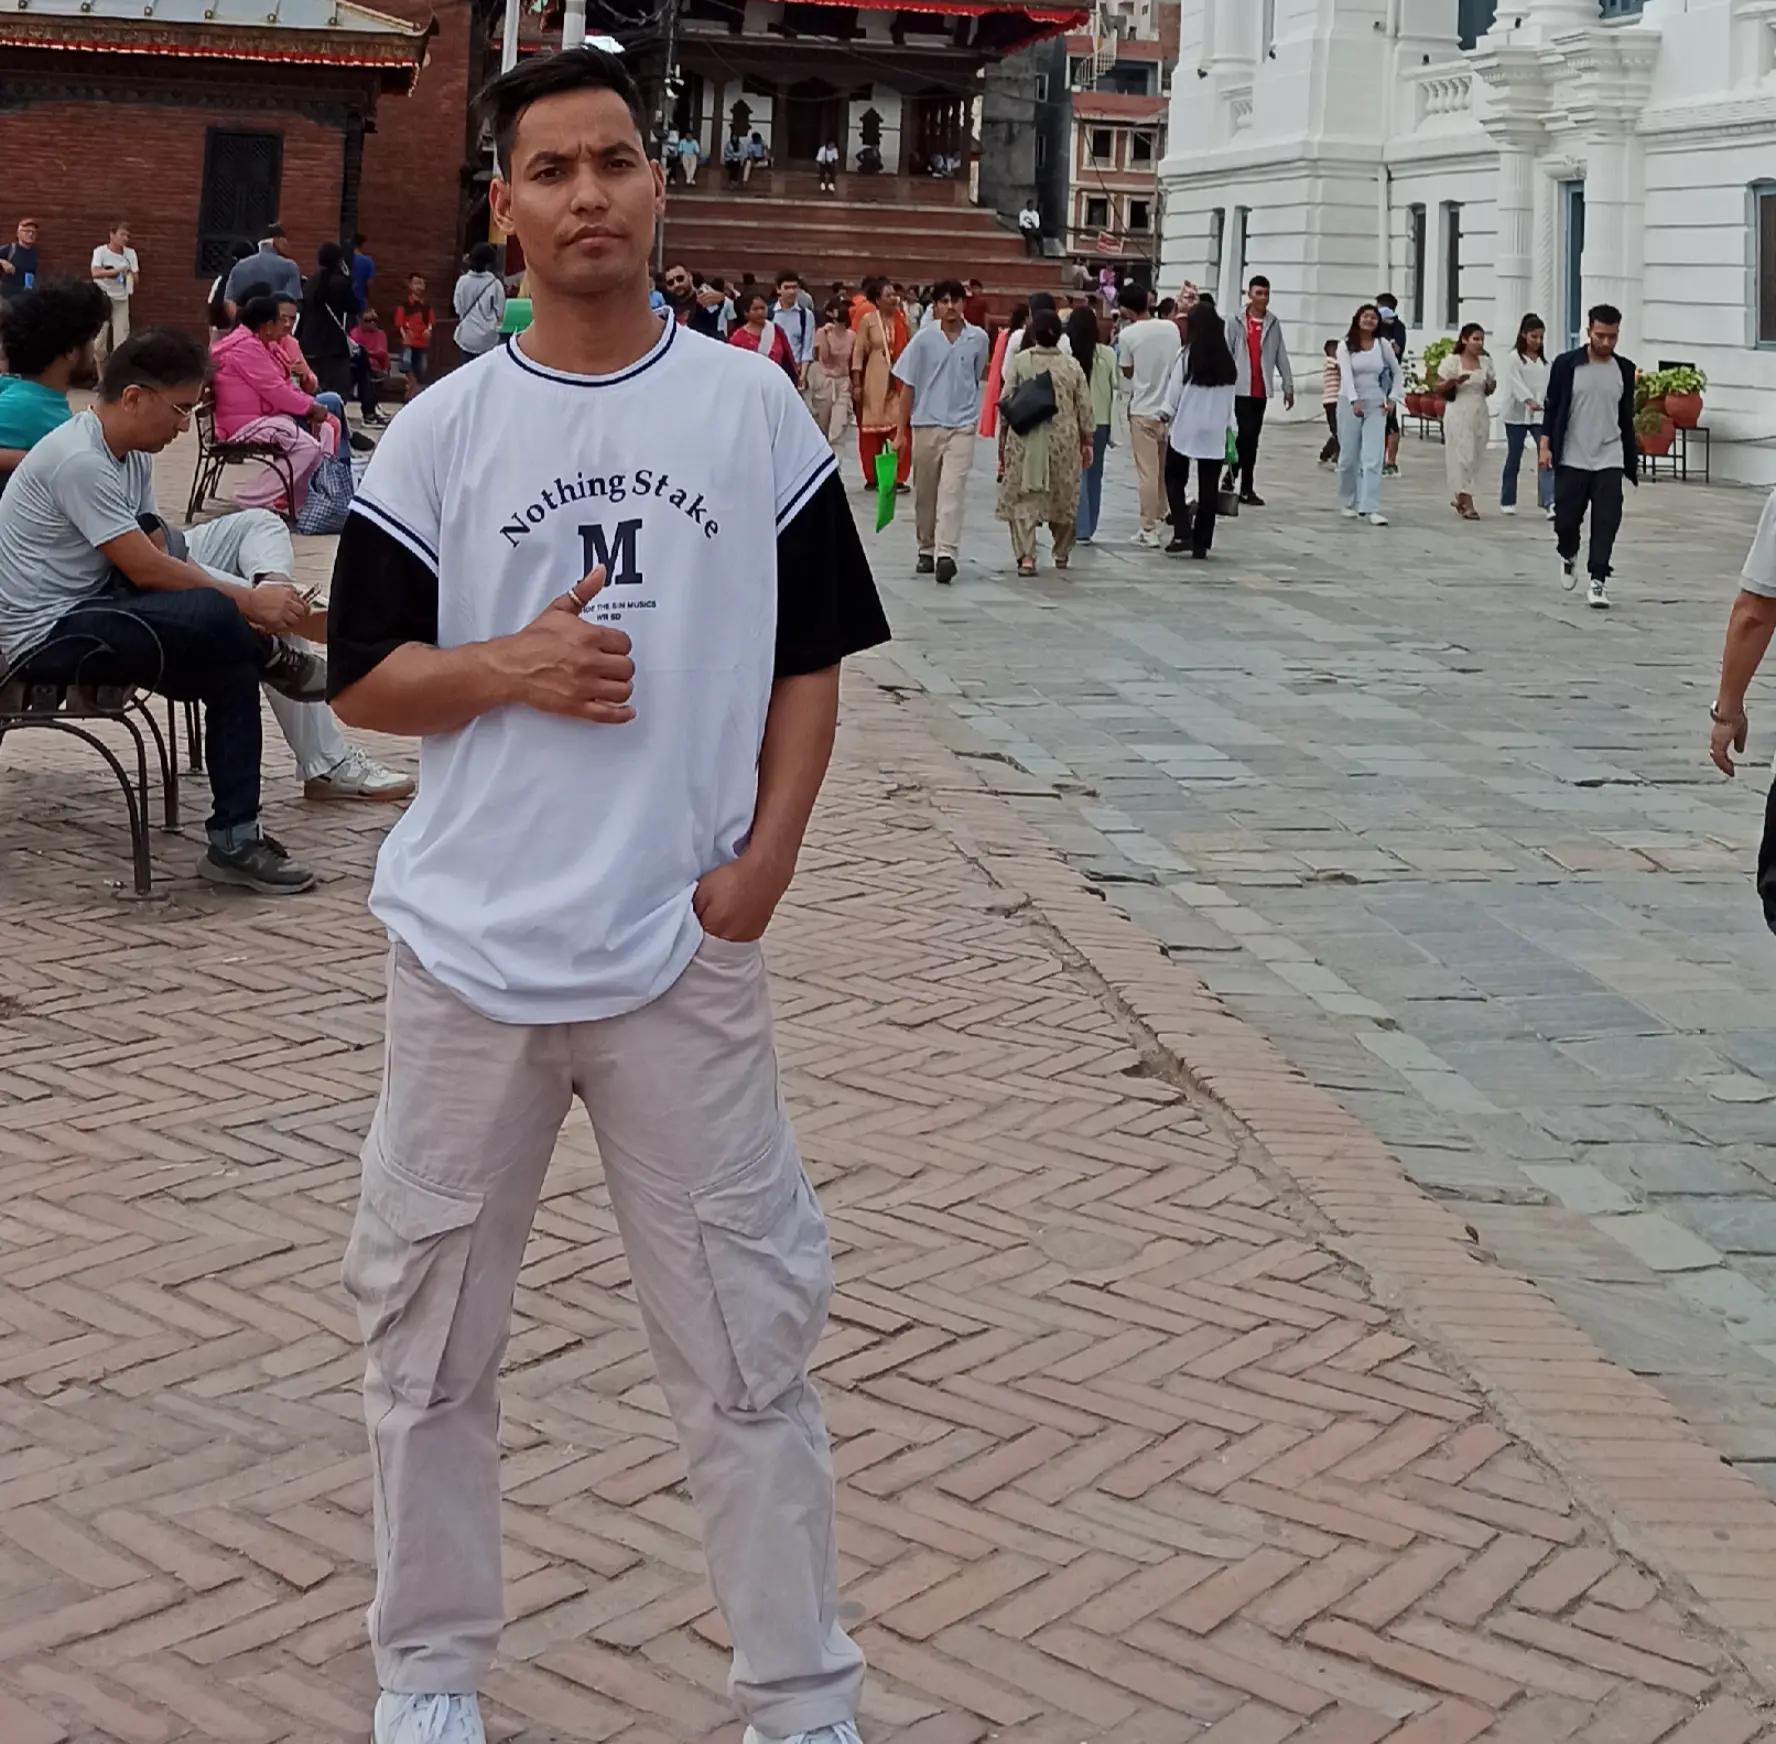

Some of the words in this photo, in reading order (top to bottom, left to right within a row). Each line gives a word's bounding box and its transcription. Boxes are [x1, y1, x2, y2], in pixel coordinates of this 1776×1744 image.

[500, 471, 626, 548] Nothing
[632, 469, 718, 539] Stake
[578, 518, 643, 587] M
